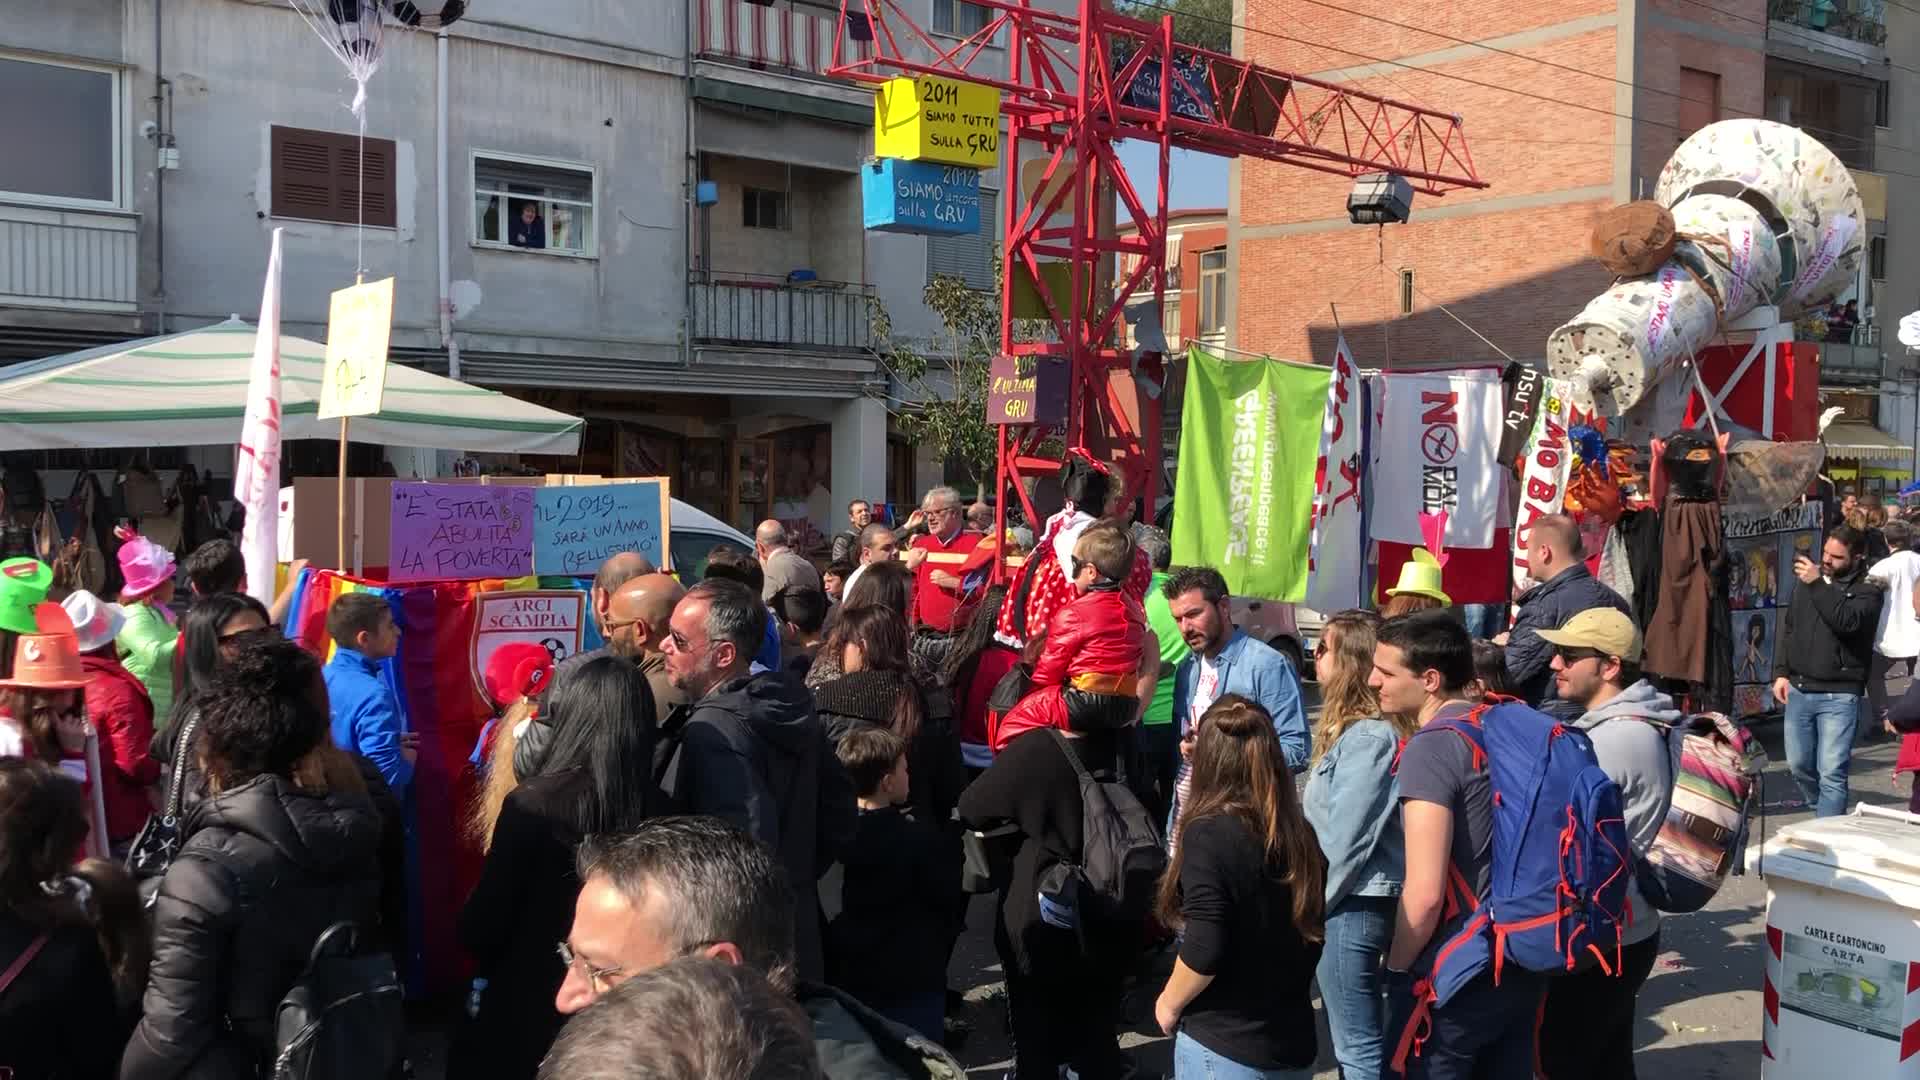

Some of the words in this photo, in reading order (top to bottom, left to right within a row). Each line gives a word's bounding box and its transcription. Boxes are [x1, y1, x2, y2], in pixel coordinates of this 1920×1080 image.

[924, 81, 959, 107] 2011
[926, 110, 956, 123] SIAMO
[962, 114, 994, 128] TUTTI
[930, 134, 963, 149] SULLA
[967, 134, 997, 157] GRU
[943, 166, 977, 188] 2012
[898, 179, 943, 201] SIAMO
[934, 203, 967, 223] GRU
[1004, 399, 1028, 418] GRU
[1224, 388, 1265, 565] GREENPEACE
[435, 498, 498, 520] STATA
[613, 518, 649, 537] ANNO
[400, 546, 425, 575] LA
[510, 599, 552, 612] ARCI
[489, 614, 568, 628] SCAMPIA
[1804, 925, 1829, 941] CARTA
[1836, 934, 1887, 955] CARTONCINO
[1822, 946, 1865, 965] CARTA
